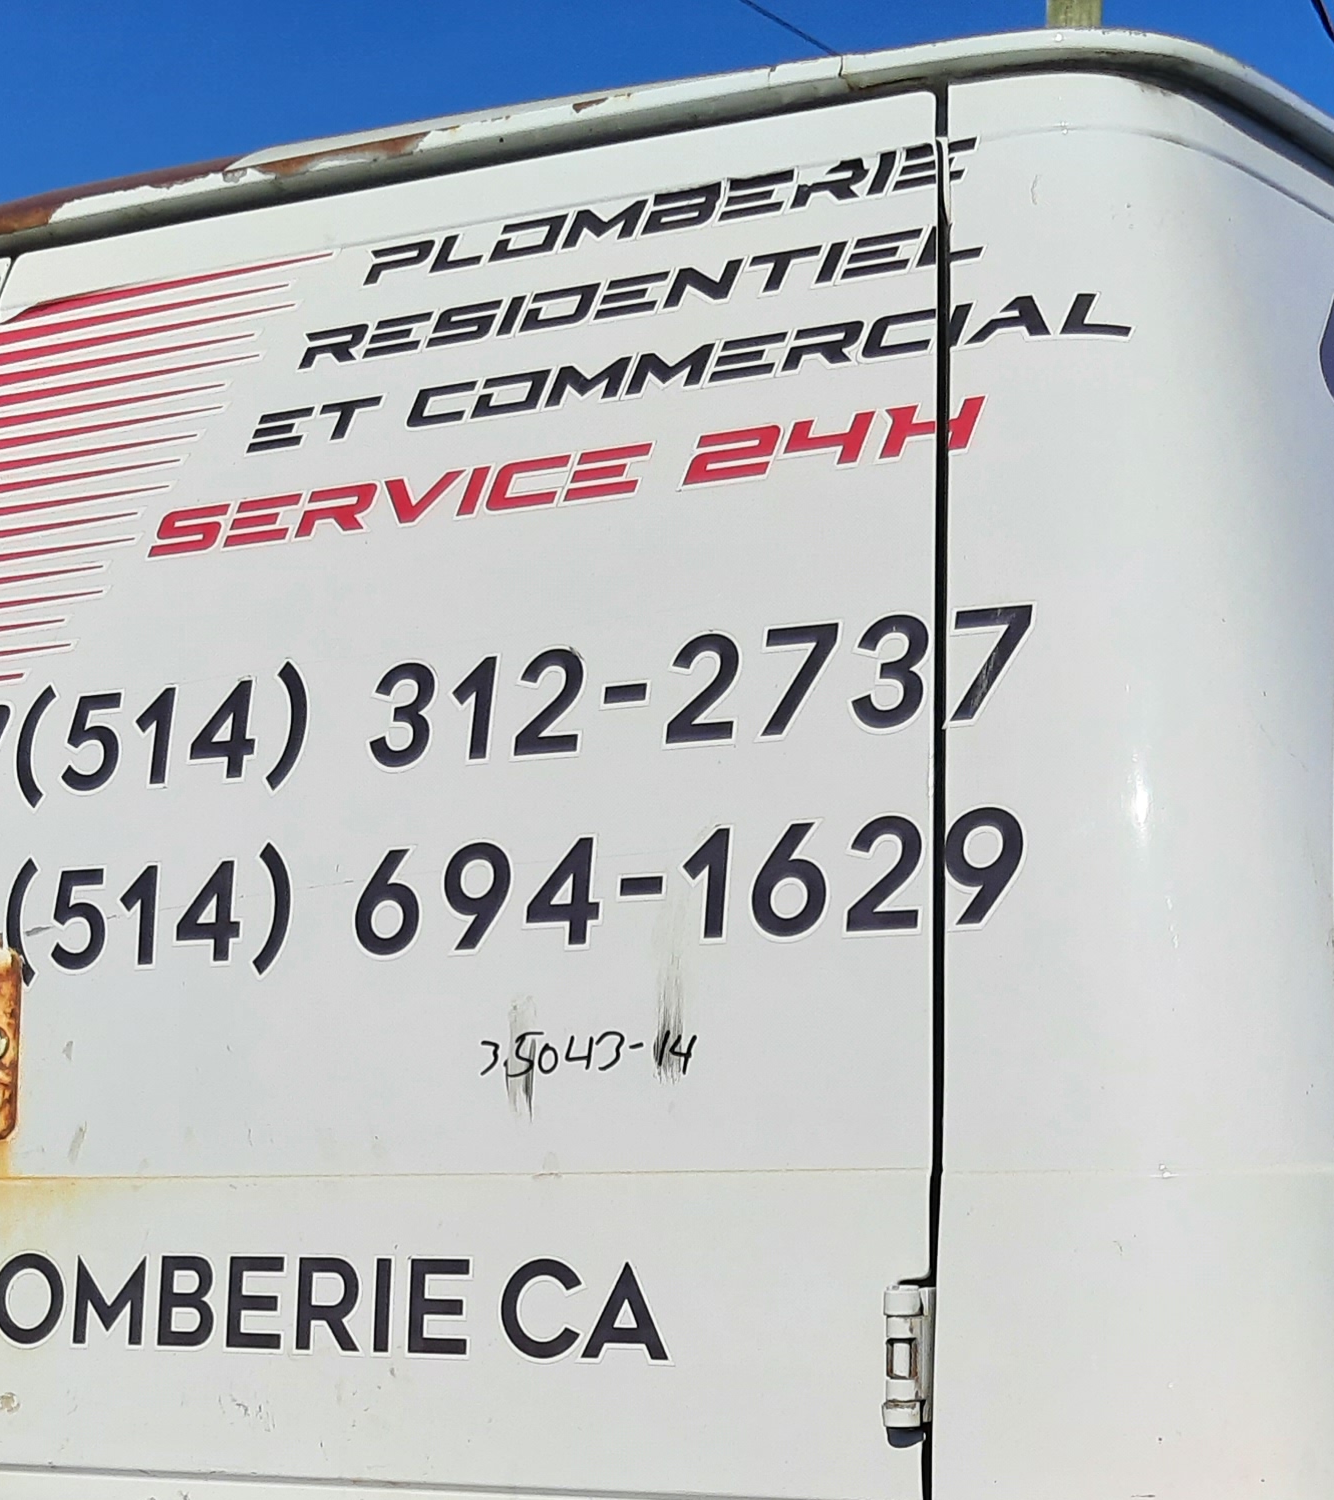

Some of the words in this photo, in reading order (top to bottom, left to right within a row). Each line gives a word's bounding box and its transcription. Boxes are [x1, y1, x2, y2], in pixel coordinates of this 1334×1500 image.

[364, 136, 979, 285] PLOMBERIE
[247, 397, 381, 453] ET
[407, 293, 1133, 428] COMMERCIAL
[299, 226, 985, 368] RESIDENTIEL
[148, 443, 653, 558] SERVICE
[681, 396, 987, 489] 24H
[17, 661, 307, 804] (514)
[370, 604, 1033, 770] 312-2737
[6, 842, 290, 986] (514)
[355, 808, 1024, 955] 694-1629
[480, 1030, 698, 1078] 35043-14
[501, 1258, 669, 1361] CA
